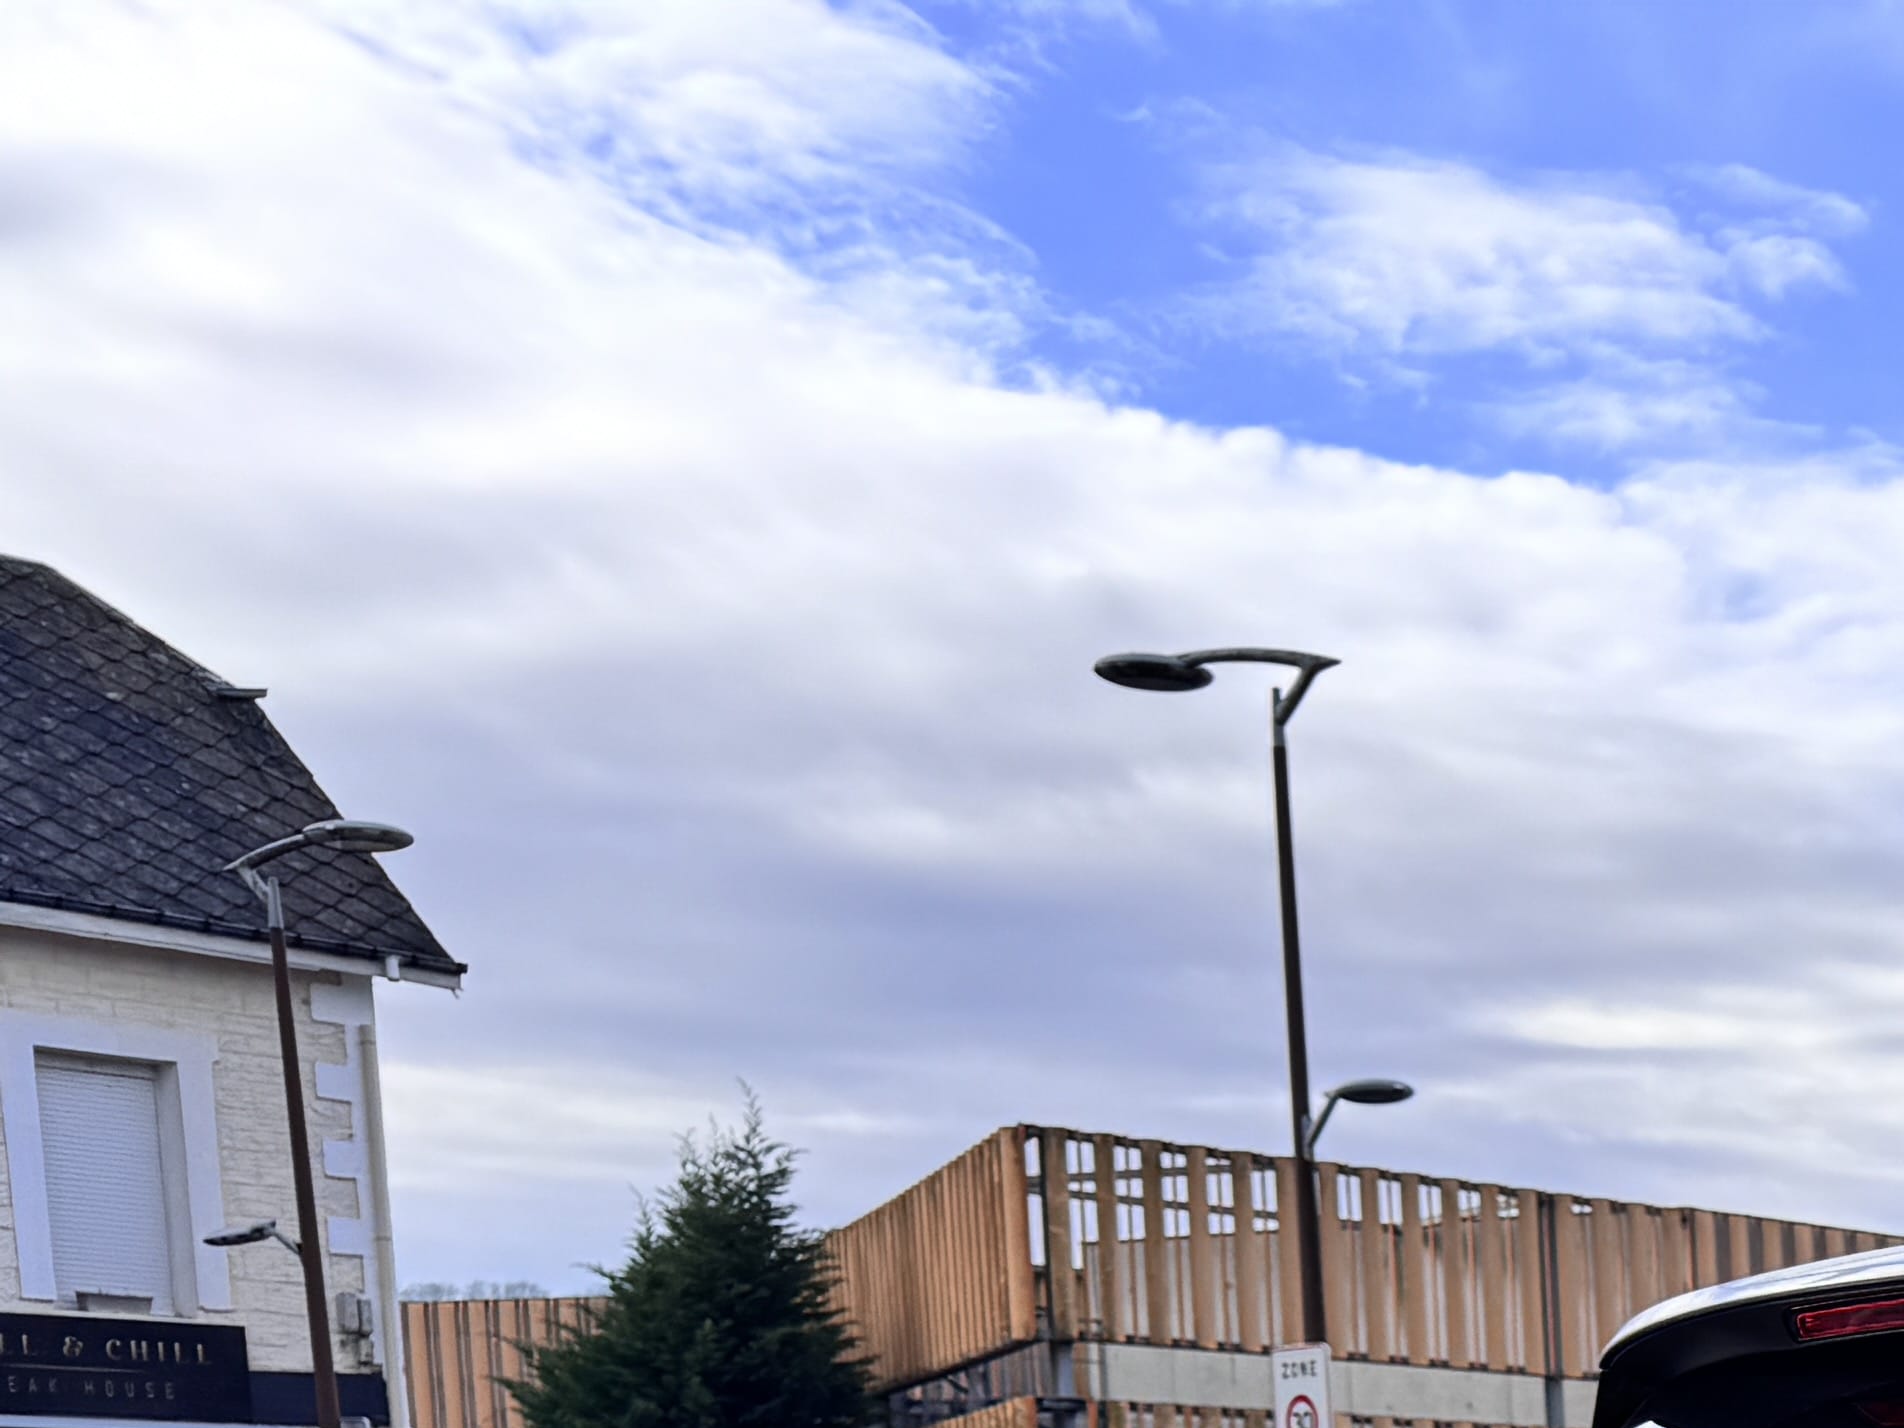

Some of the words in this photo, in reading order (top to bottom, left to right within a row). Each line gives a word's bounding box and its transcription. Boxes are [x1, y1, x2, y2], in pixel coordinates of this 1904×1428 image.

[62, 1335, 84, 1357] &
[105, 1338, 213, 1365] CHILL
[1281, 1360, 1318, 1380] ZONE
[85, 1380, 175, 1400] HOUSE
